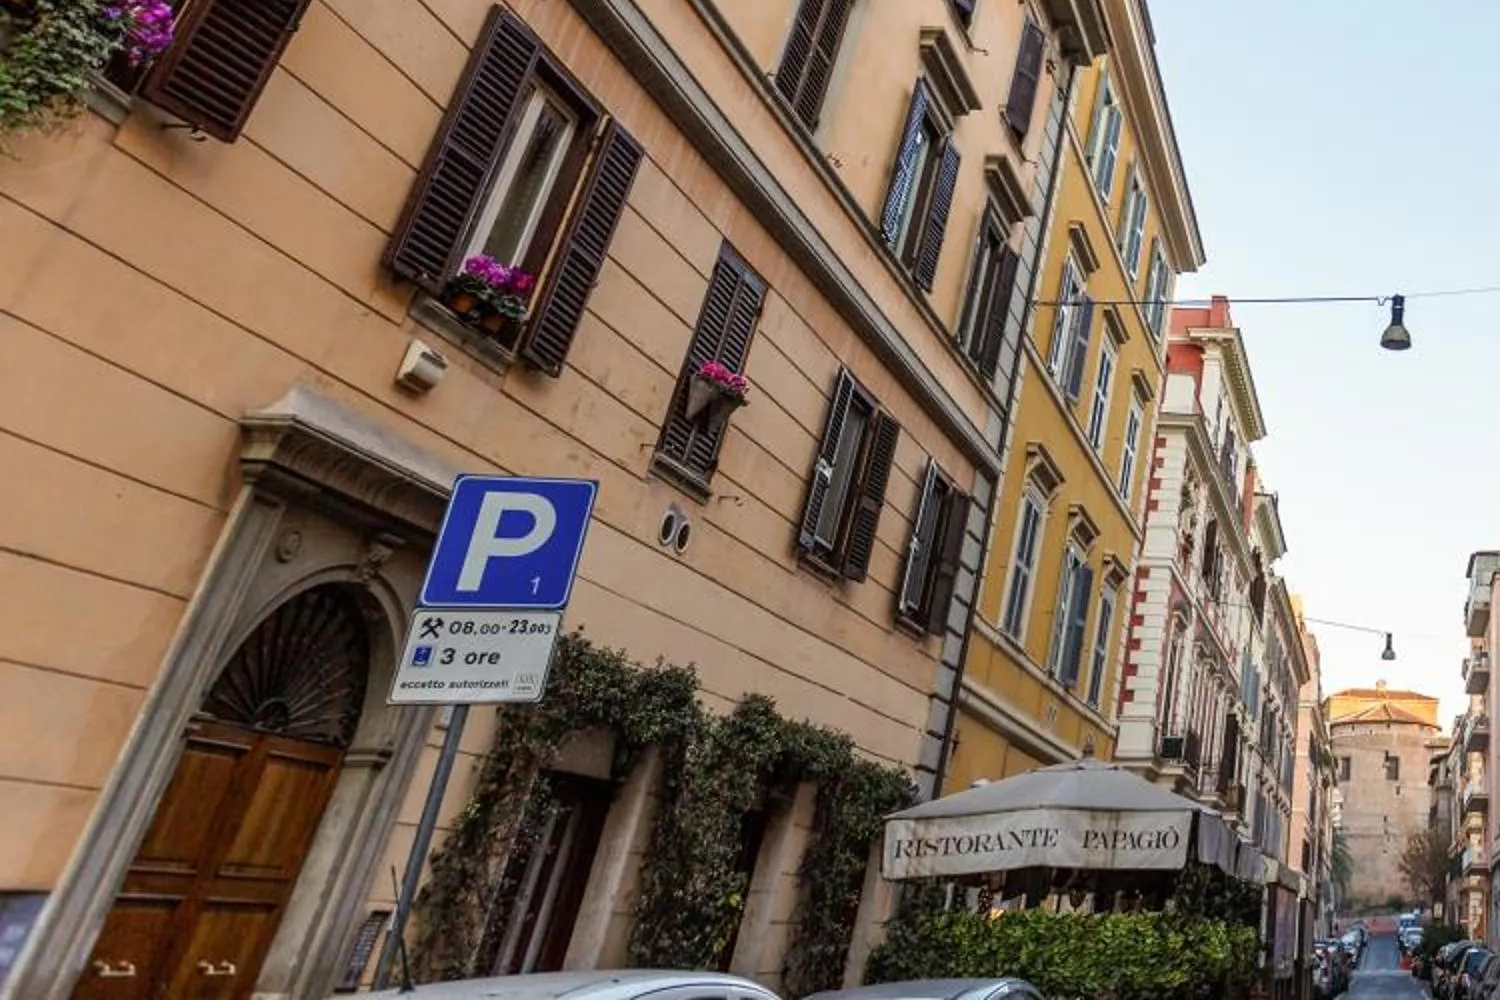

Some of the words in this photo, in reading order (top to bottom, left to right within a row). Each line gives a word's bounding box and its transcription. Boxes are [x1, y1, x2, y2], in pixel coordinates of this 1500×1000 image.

[456, 491, 556, 592] P
[440, 648, 456, 665] 3
[464, 652, 501, 665] ore
[400, 679, 445, 690] eccetto
[894, 828, 1060, 859] RISTORANTE
[1082, 825, 1180, 851] PAPAGIÒ
